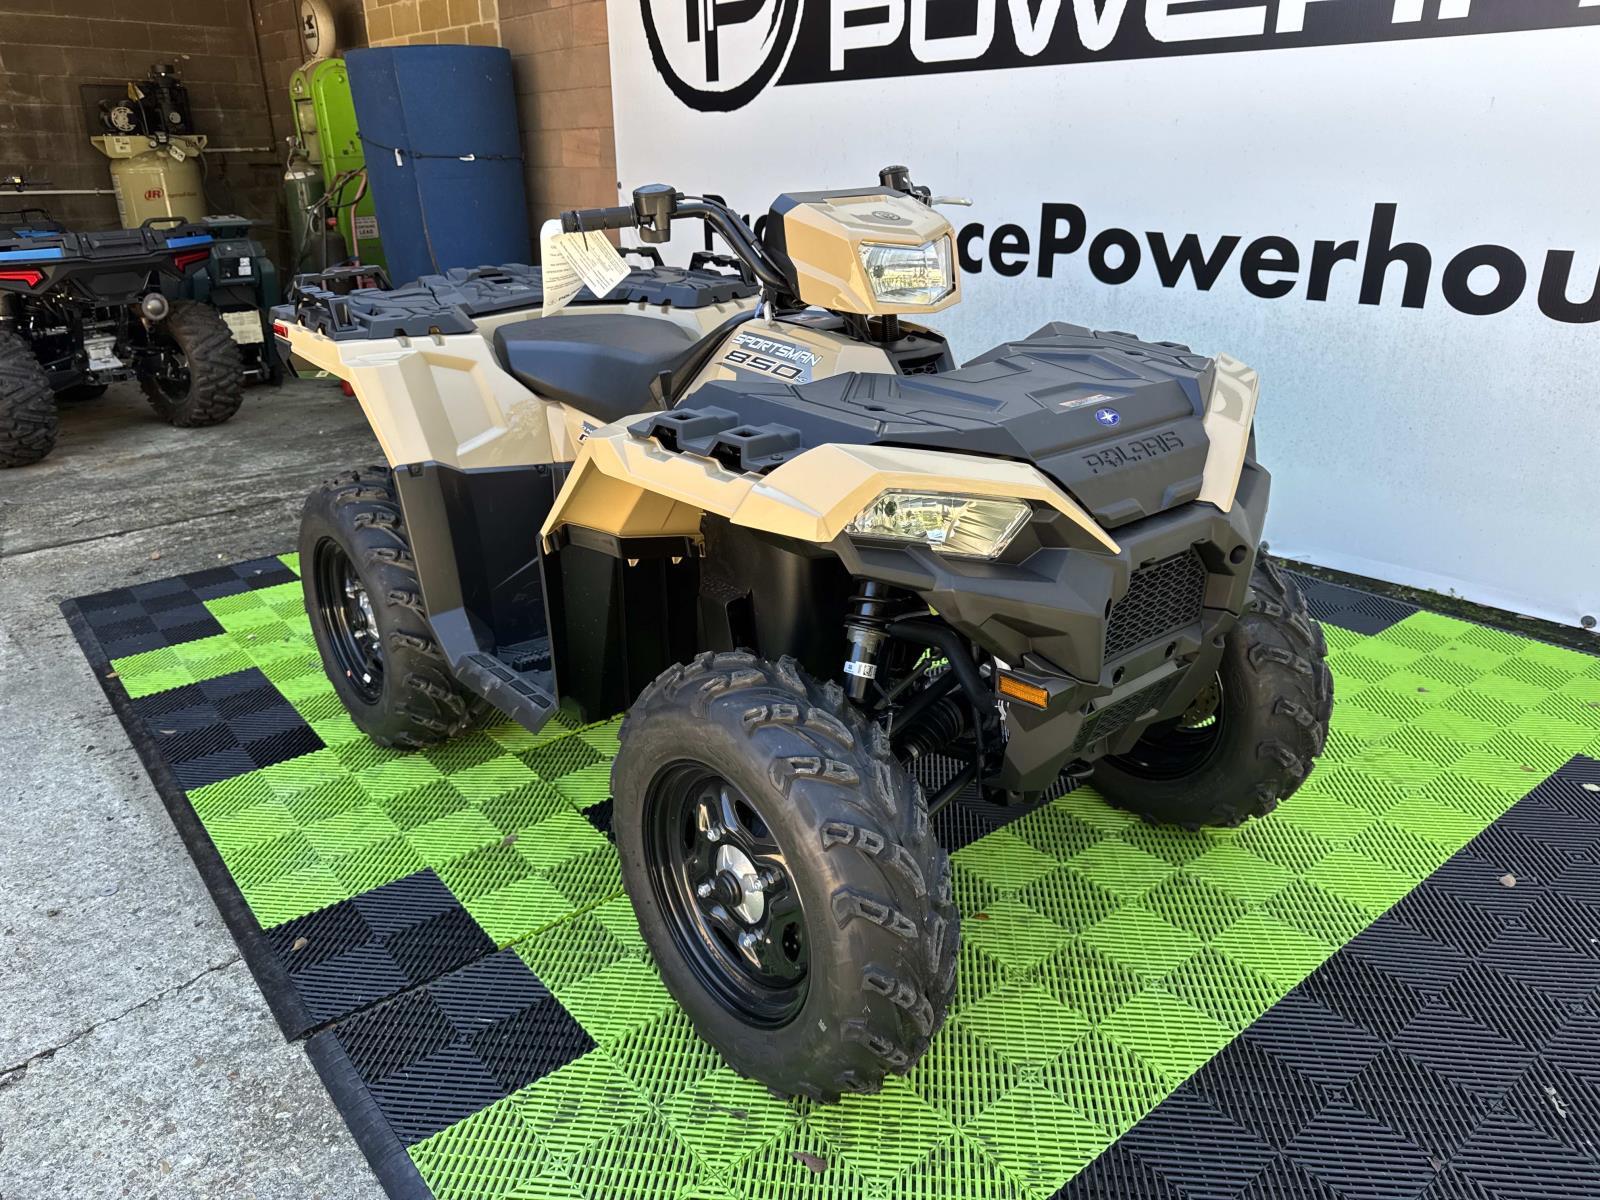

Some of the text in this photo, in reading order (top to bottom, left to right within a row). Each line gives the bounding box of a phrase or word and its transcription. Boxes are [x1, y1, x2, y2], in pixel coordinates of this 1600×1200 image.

[829, 0, 1600, 71] POW
[724, 349, 804, 380] 850
[732, 334, 824, 366] SPORTSMAN
[1081, 430, 1185, 474] POLARIS
